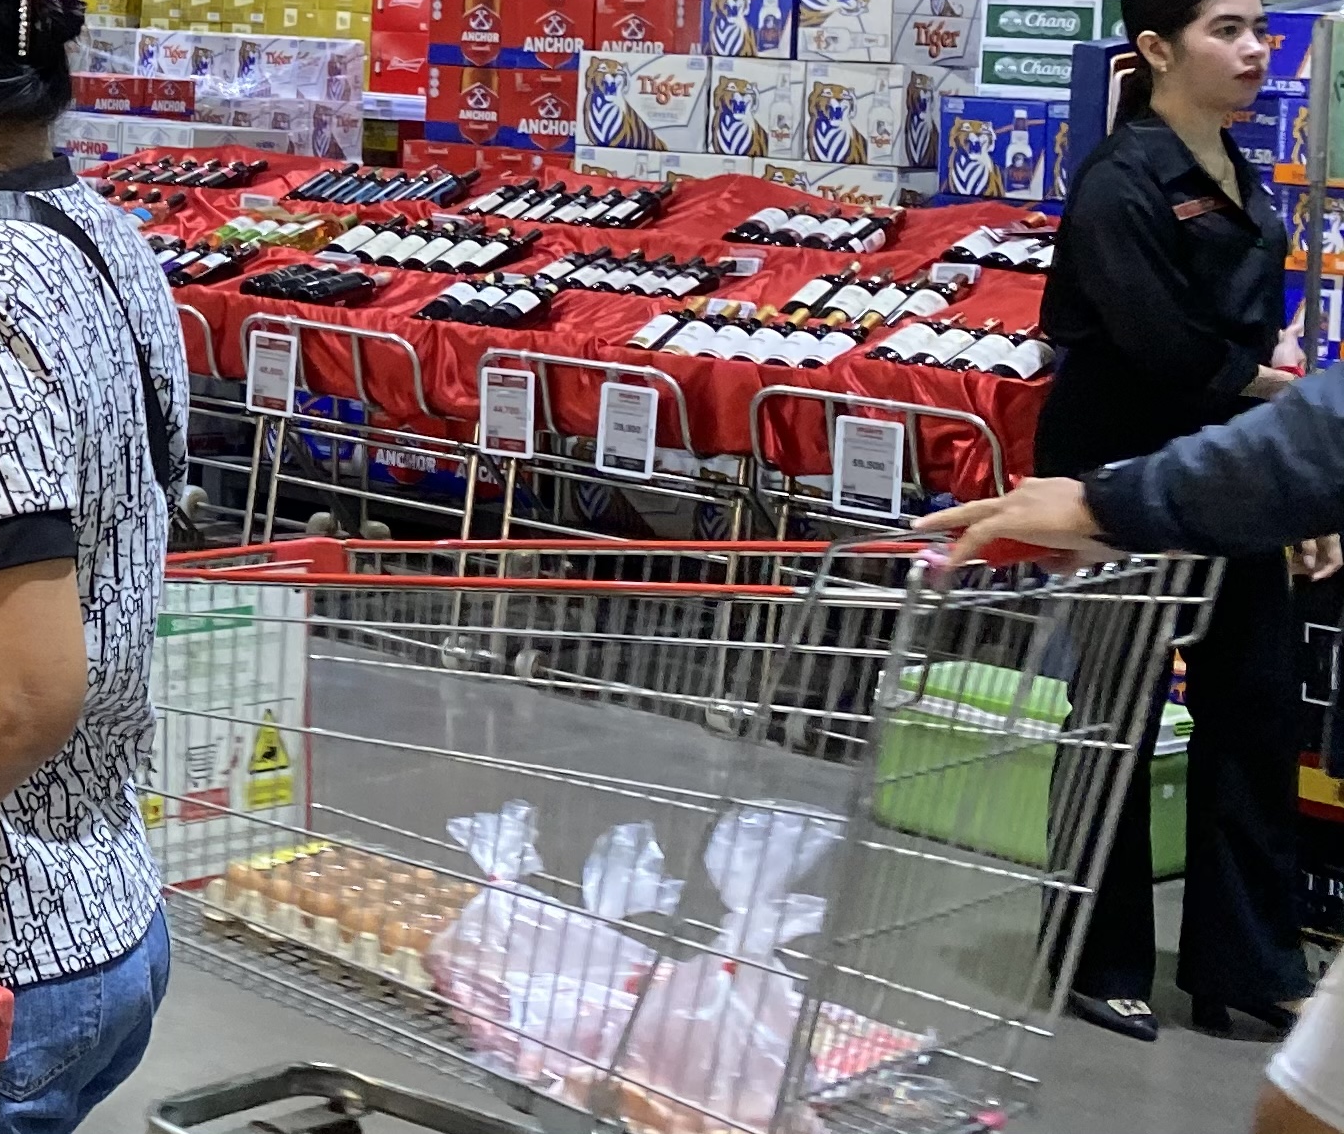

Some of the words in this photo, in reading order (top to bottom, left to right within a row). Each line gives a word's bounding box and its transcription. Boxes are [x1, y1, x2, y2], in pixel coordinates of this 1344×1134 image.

[1024, 11, 1077, 33] Chang
[461, 32, 500, 43] ANCHOR
[523, 36, 584, 54] ANCHOR
[912, 20, 961, 59] Tiger
[601, 40, 665, 54] ANCHOR
[1020, 57, 1072, 79] Chang
[636, 73, 696, 106] Tiger
[94, 99, 131, 112] ANCHOR
[151, 100, 187, 113] ANCHOR
[458, 109, 498, 122] ANCHOR
